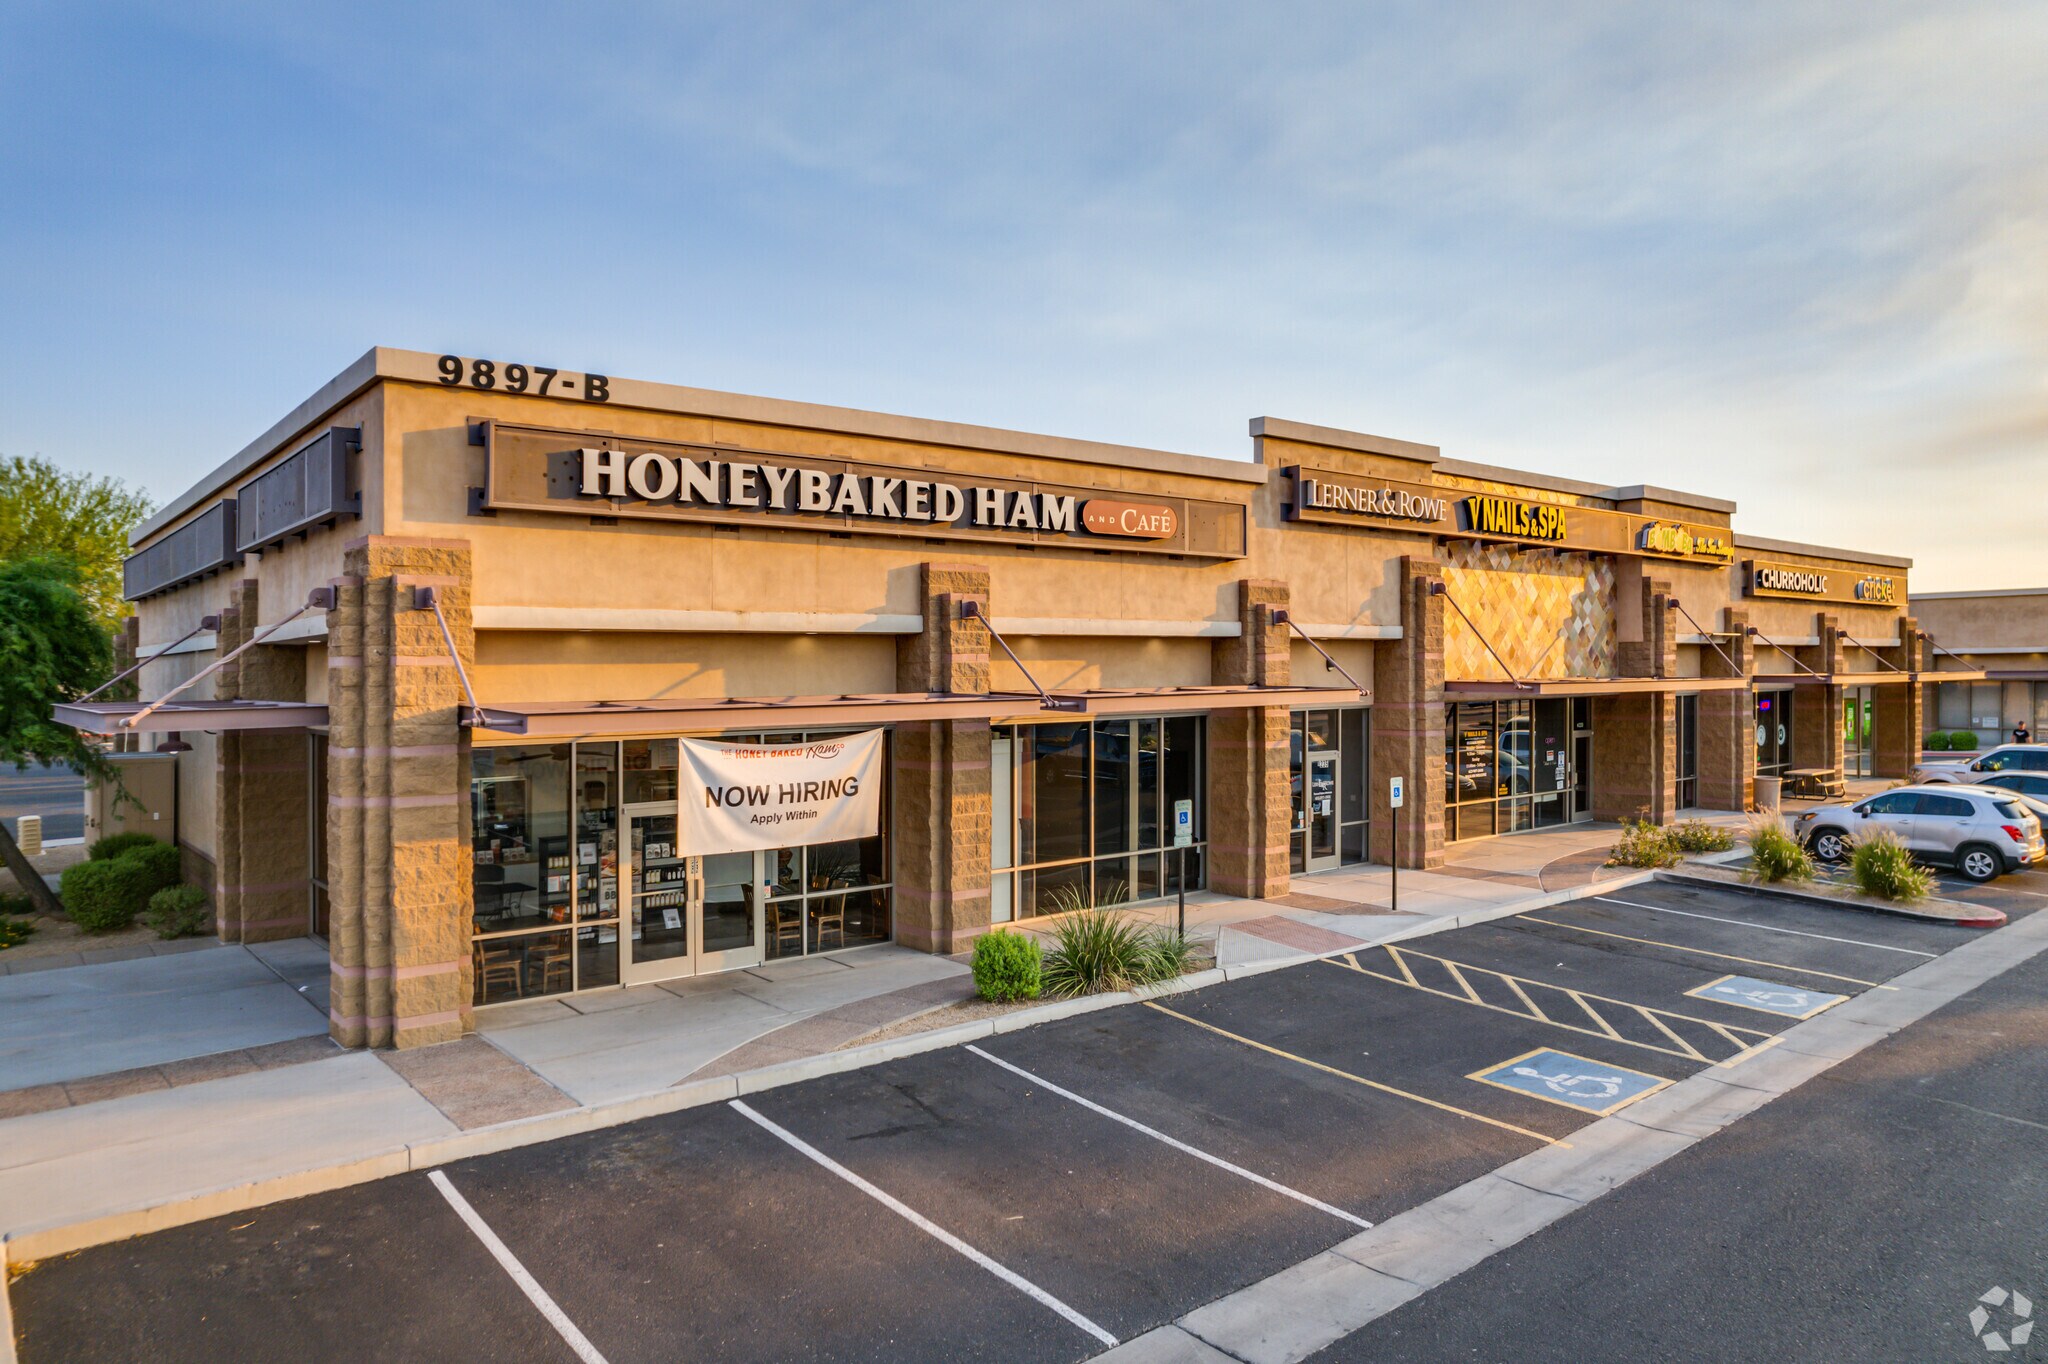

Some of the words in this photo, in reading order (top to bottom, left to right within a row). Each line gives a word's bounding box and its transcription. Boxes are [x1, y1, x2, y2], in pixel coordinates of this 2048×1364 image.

[438, 355, 610, 402] 9897-B
[579, 447, 965, 522] HONEYBAKED
[974, 486, 1076, 532] HAM
[1088, 514, 1117, 525] AND
[1306, 478, 1378, 513] LERNER
[1399, 489, 1447, 521] ROWE
[1538, 505, 1567, 540] SPA
[1761, 568, 1828, 594] CHURROHOLIC
[1863, 577, 1896, 602] cricket
[720, 748, 732, 757] THE
[735, 749, 767, 759] HONEY
[770, 747, 803, 758] BAKED
[705, 784, 770, 808] NOW
[778, 776, 859, 804] HIRING
[750, 812, 783, 825] Apply
[786, 809, 818, 821] Within
